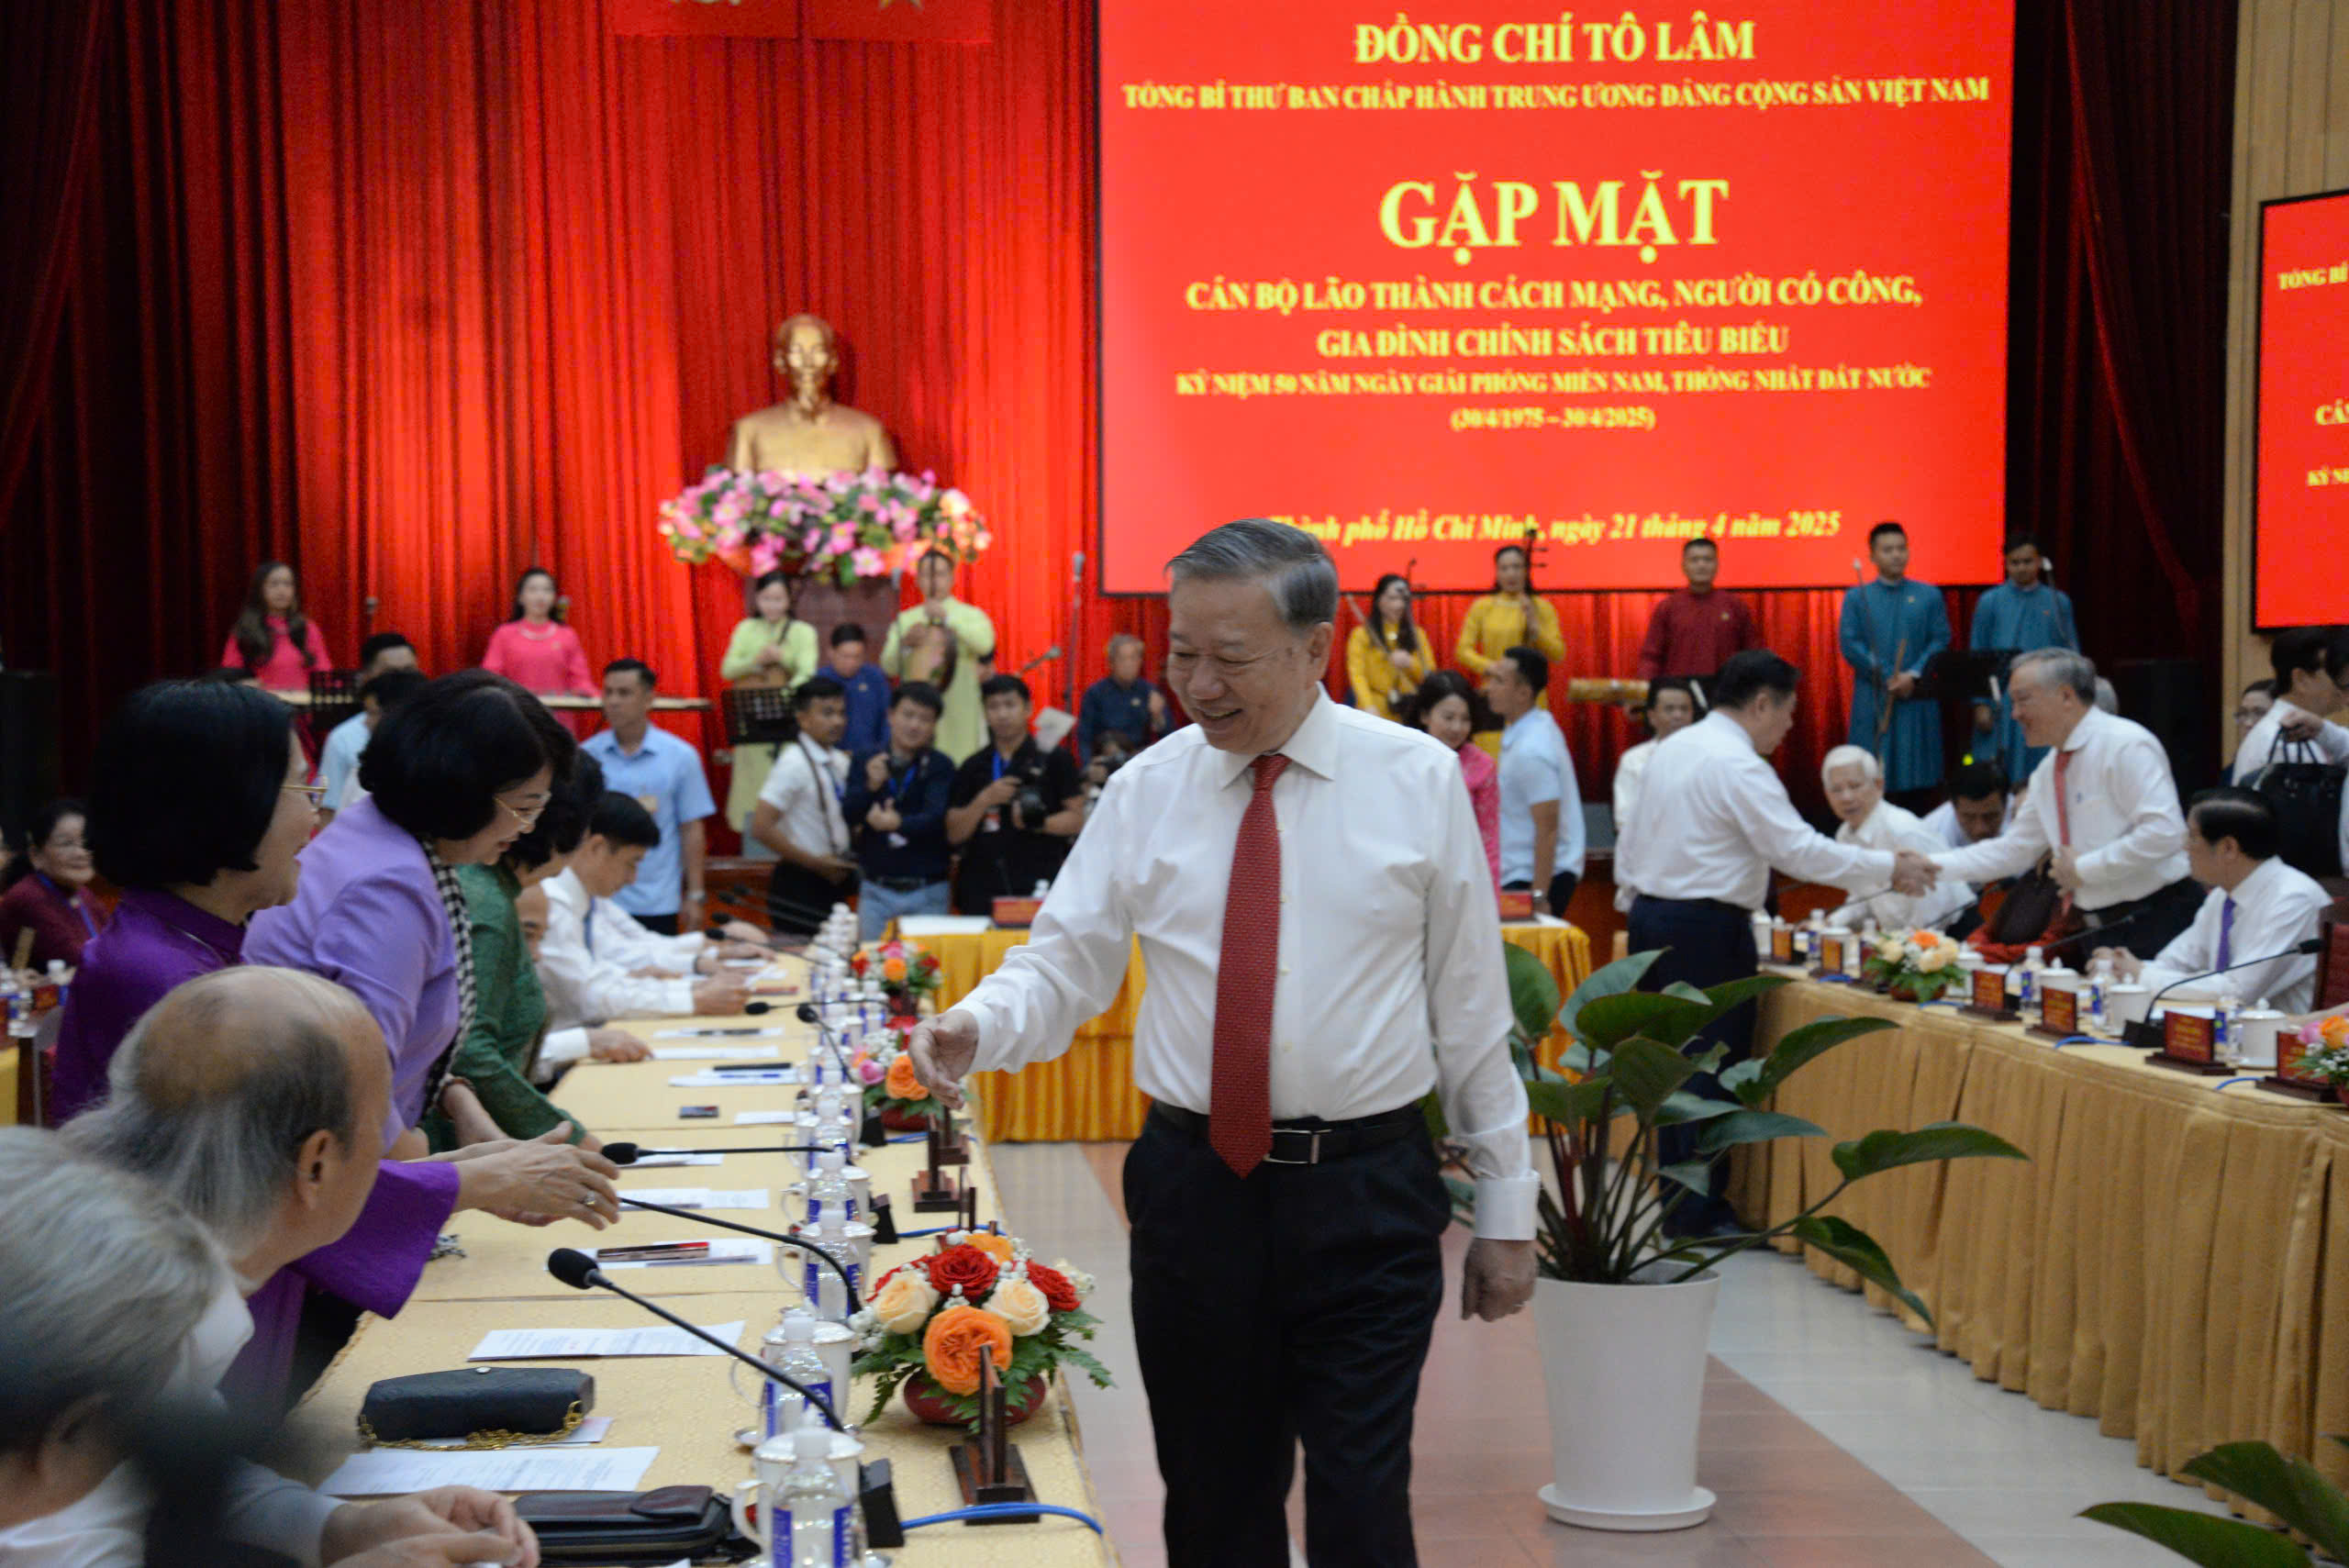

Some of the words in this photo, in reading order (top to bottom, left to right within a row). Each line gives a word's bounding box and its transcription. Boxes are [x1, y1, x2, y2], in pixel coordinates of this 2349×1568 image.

[1354, 13, 1483, 63] ĐỒNG
[1492, 12, 1574, 63] CHÍ
[1582, 11, 1646, 61] TÔ
[1656, 10, 1754, 61] LÂM
[1199, 80, 1226, 109] BÍ
[1229, 83, 1286, 109] THƯ
[1288, 85, 1340, 109] BAN
[1415, 80, 1487, 109] HÀNH
[1491, 84, 1577, 108] TRUNG
[1582, 82, 1655, 107] ƯƠNG
[1735, 80, 1809, 110] CỘNG
[1866, 76, 1926, 107] VIỆT
[1930, 77, 1988, 102] NAM
[1379, 172, 1539, 265] GẶP
[1553, 170, 1730, 264] MẶT
[1186, 275, 1250, 310] CÁN
[1255, 280, 1299, 315] BỘ
[1303, 276, 1366, 309] LÃO
[1370, 274, 1475, 309] THÀNH
[1478, 273, 1564, 309] CÁCH
[1570, 279, 1669, 314] MẠNG,
[1674, 272, 1772, 306] NGƯỜI
[1777, 271, 1823, 306] CÓ
[1827, 270, 1923, 306] CÔNG,
[1317, 329, 1373, 357] GIA
[1455, 322, 1553, 357] CHÍNH
[1557, 321, 1638, 356] SÁCH
[1642, 320, 1711, 355] TIÊU
[1212, 372, 1272, 399] NIỆM
[1273, 373, 1298, 395] 50
[2314, 398, 2349, 426] CÁ
[1341, 508, 1390, 547] phố
[1392, 508, 1429, 541] Hồ
[1431, 514, 1476, 540] Chí
[1550, 513, 1607, 545] ngày
[1609, 513, 1638, 539] 21
[1641, 511, 1708, 540] tháng
[1710, 512, 1729, 538] 4
[1730, 511, 1782, 538] năm
[1786, 510, 1842, 538] 2025
